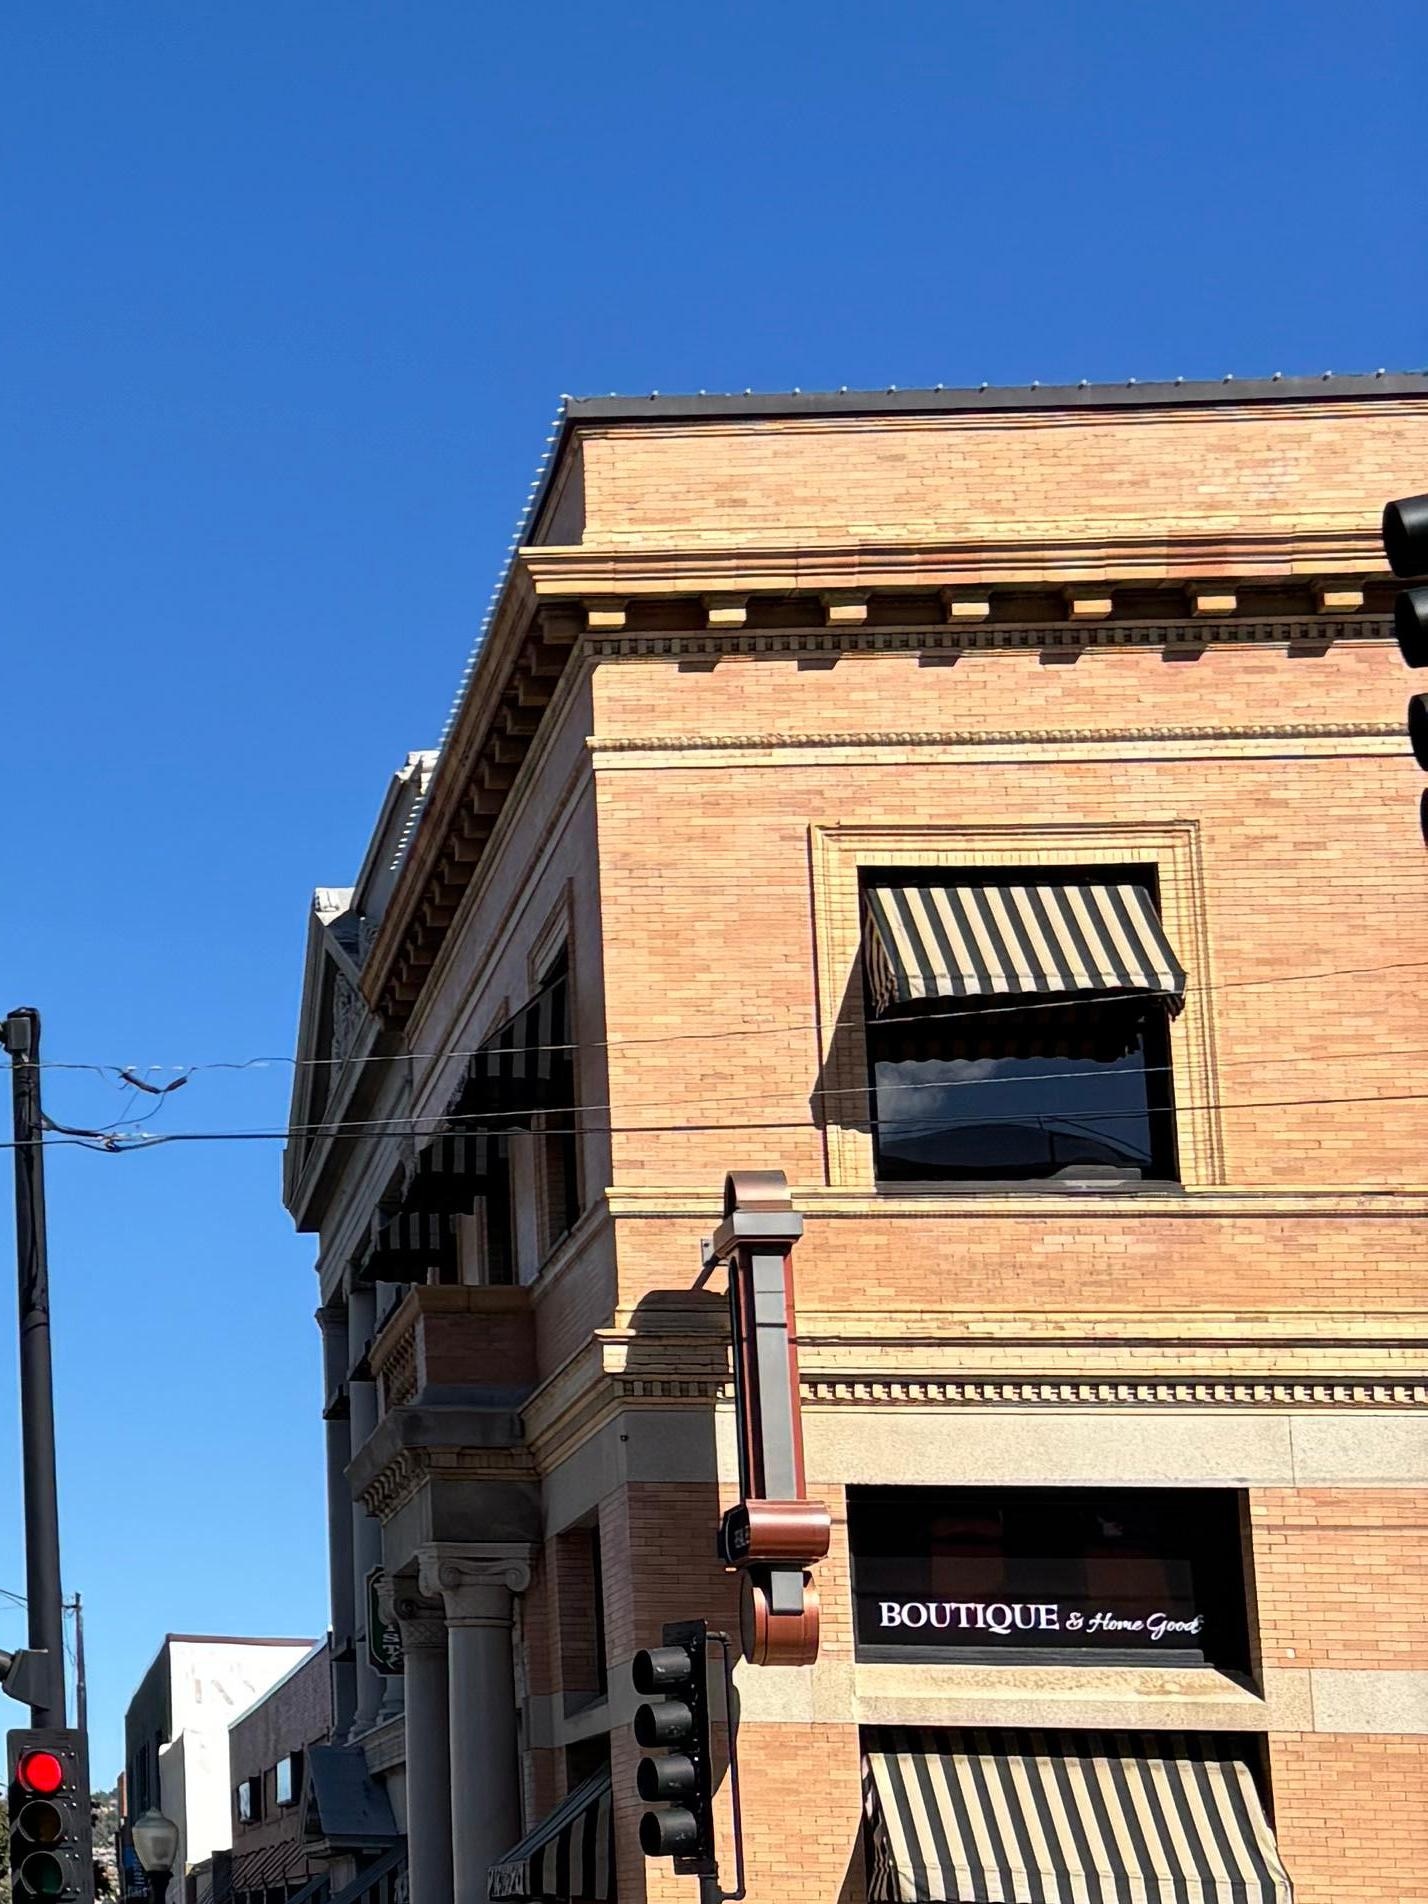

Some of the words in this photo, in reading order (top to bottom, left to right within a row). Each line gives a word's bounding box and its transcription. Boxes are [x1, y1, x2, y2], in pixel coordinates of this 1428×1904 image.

[879, 1602, 1060, 1634] BOUTIQUE
[1065, 1611, 1084, 1630] &
[1086, 1612, 1144, 1633] Home
